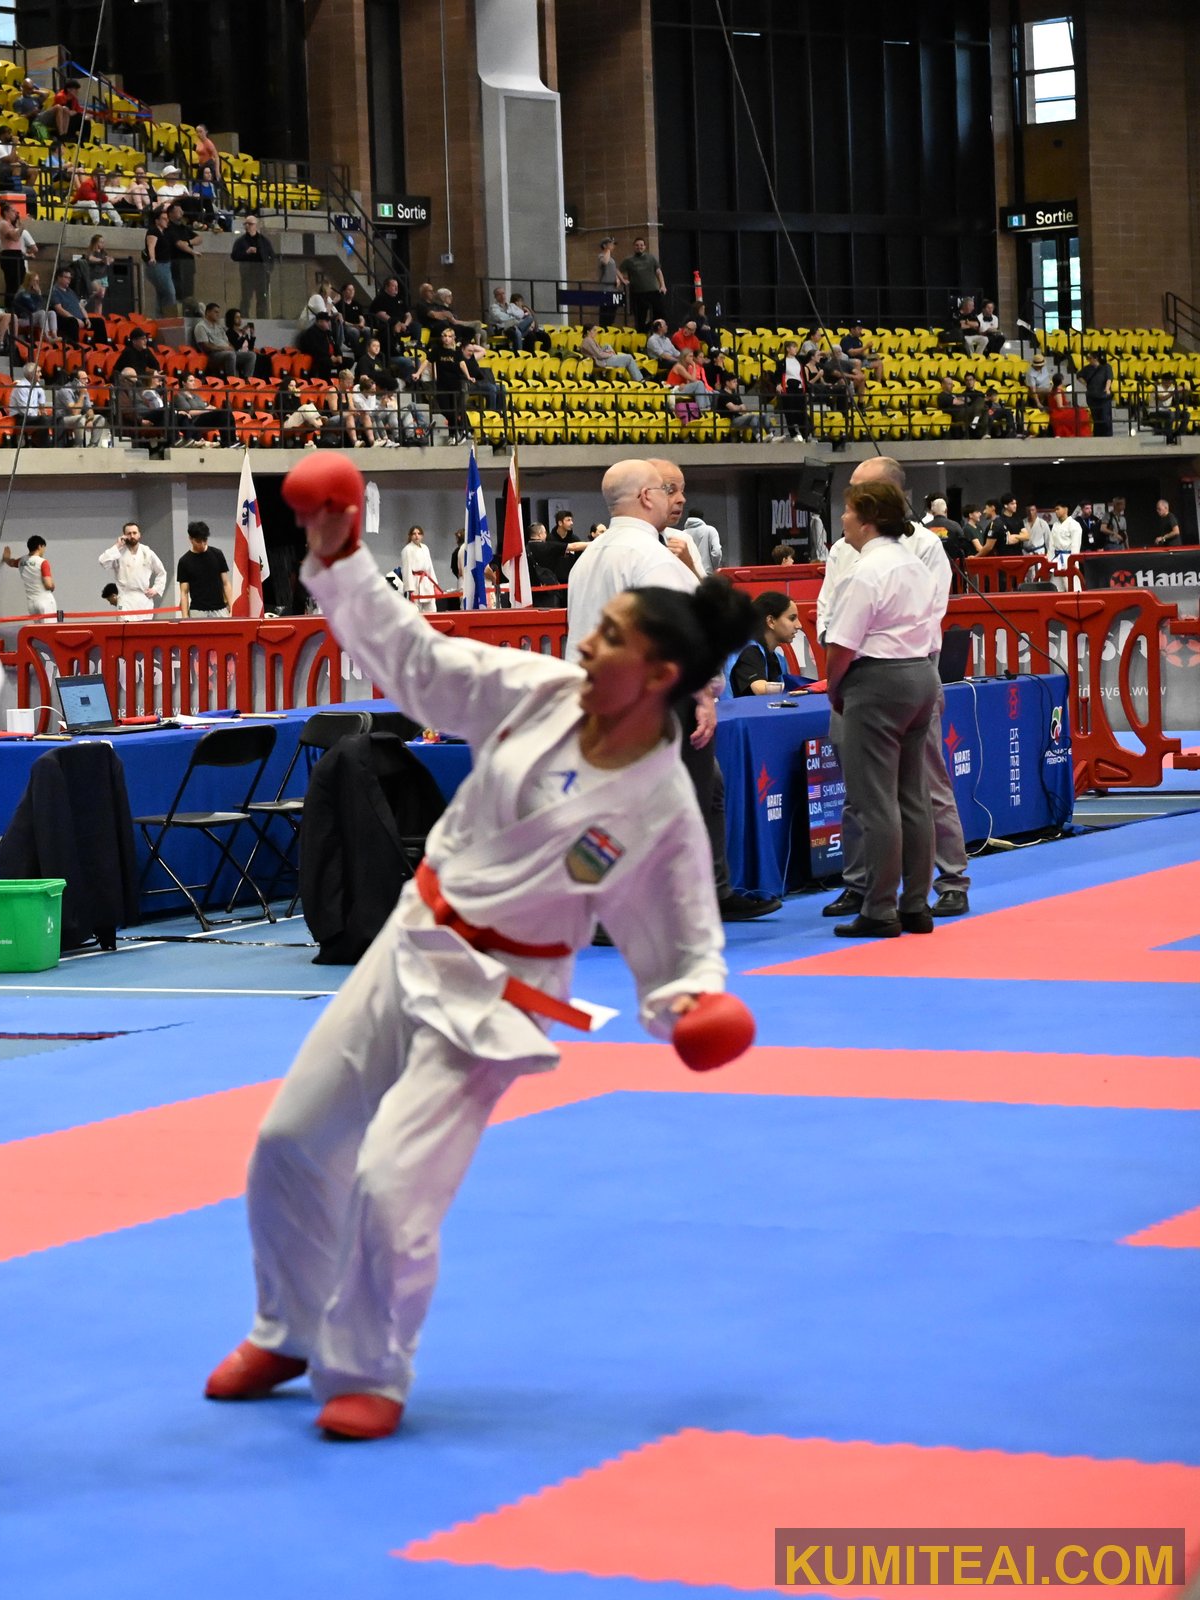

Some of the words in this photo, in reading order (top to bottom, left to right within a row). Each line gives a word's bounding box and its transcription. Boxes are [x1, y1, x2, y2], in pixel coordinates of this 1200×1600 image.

[397, 203, 427, 220] Sortie
[1036, 209, 1073, 225] Sortie
[1135, 569, 1200, 587] Haya
[807, 758, 820, 771] CAN
[809, 802, 822, 815] USA
